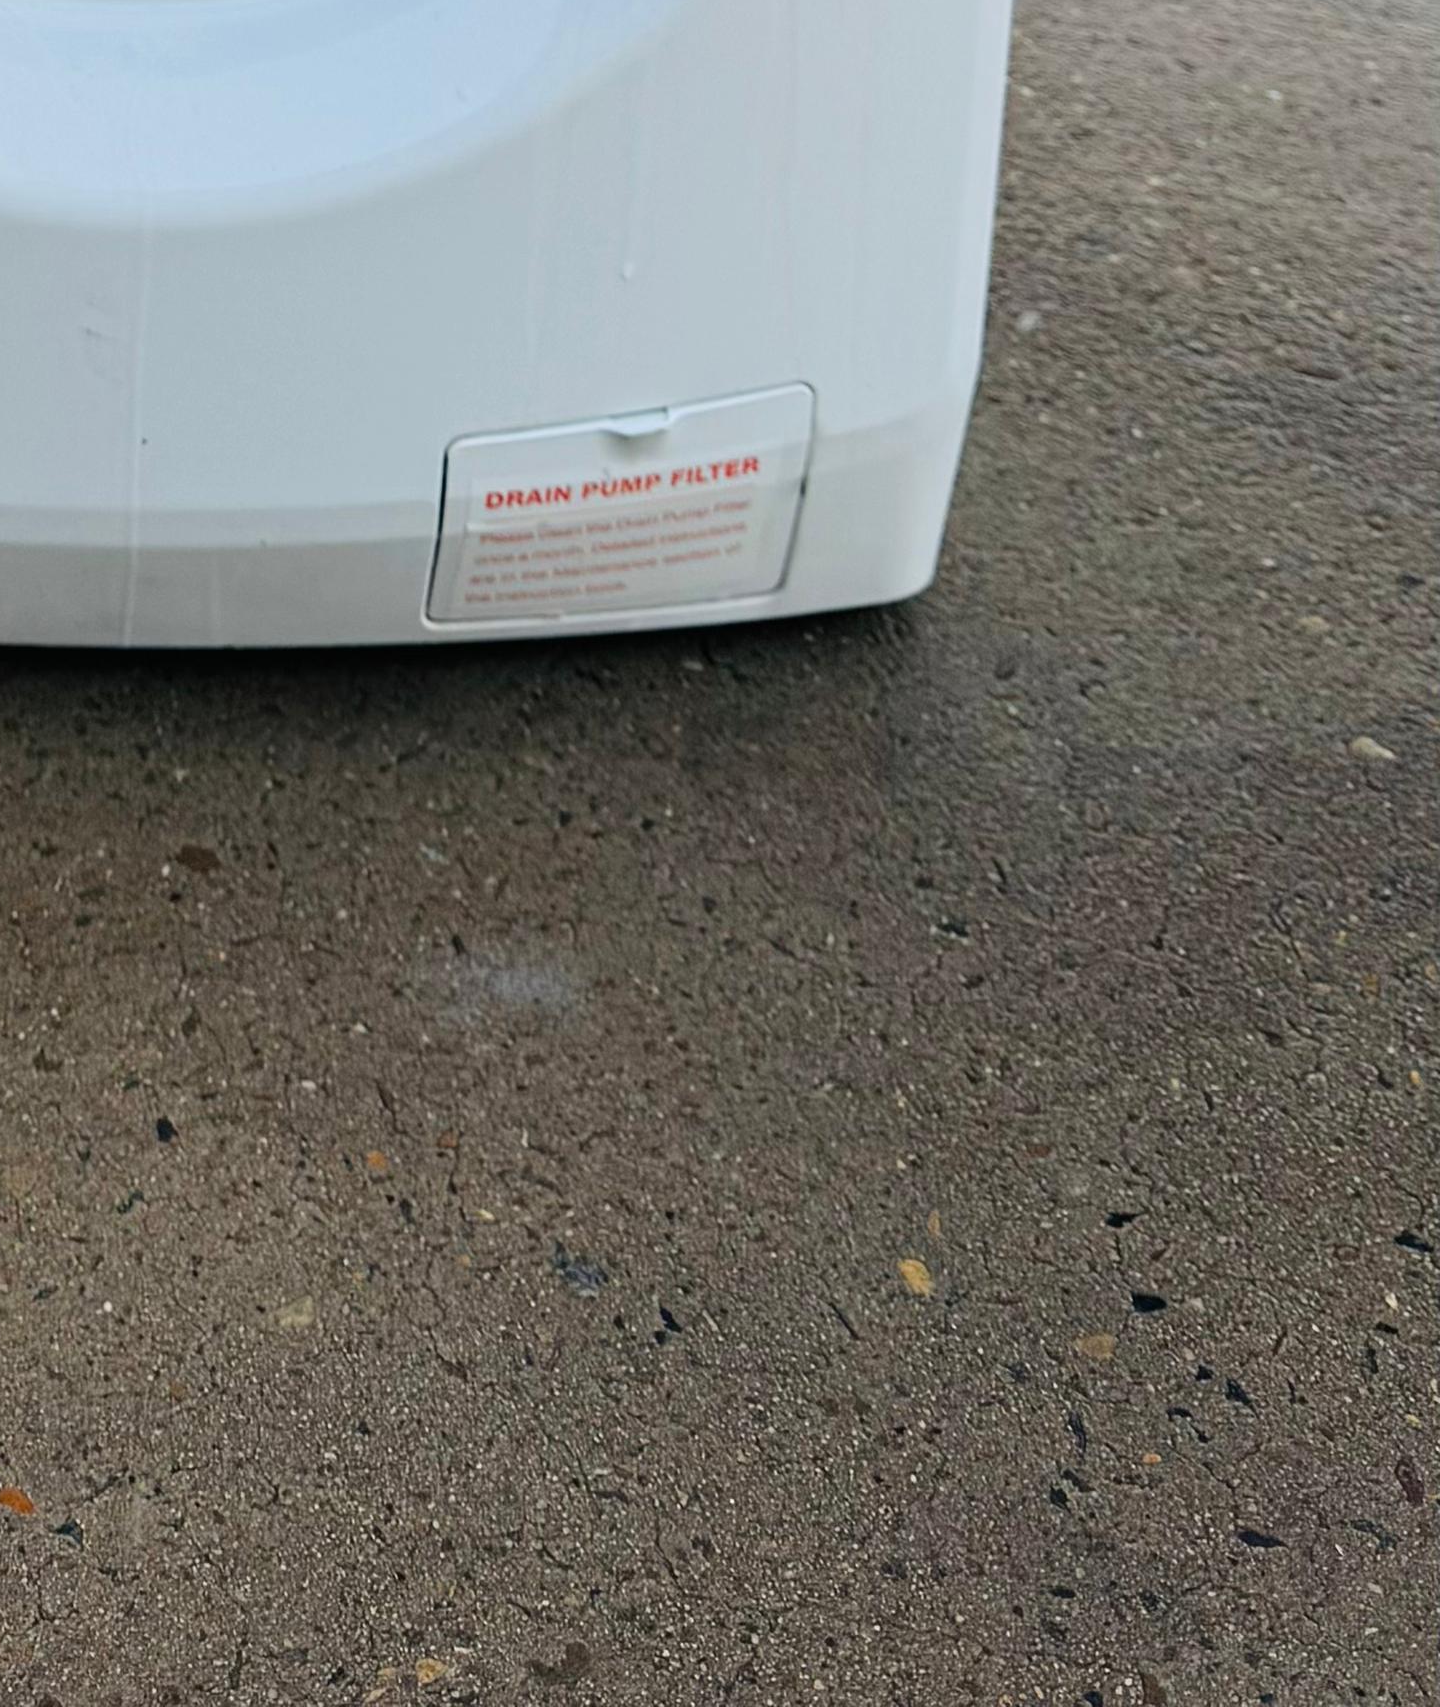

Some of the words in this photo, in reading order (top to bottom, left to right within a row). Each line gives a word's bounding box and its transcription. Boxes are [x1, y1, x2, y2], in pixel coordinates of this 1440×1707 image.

[484, 486, 572, 511] DRAIN
[580, 472, 663, 500] PUMP
[669, 455, 762, 488] FILTER
